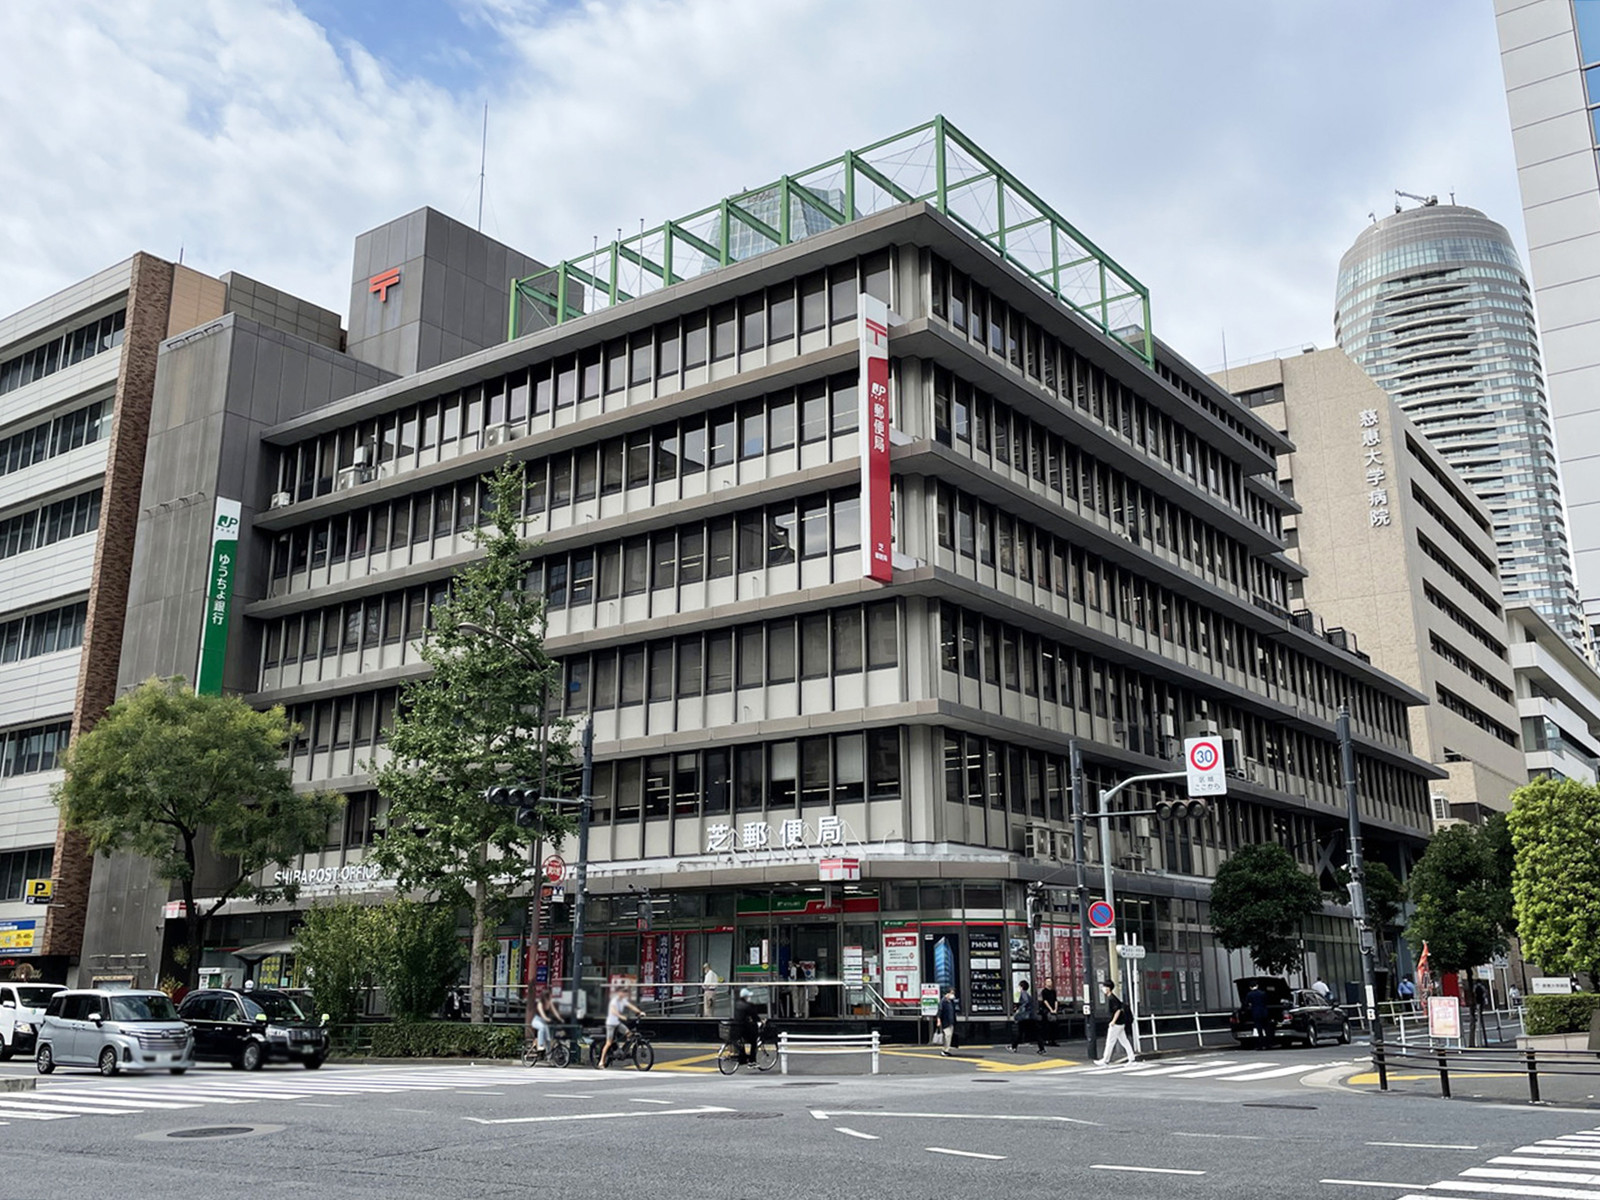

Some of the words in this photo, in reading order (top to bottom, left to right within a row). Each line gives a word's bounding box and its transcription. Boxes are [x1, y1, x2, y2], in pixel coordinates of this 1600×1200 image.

[874, 402, 885, 453] 郵便局
[212, 554, 230, 626] ゆうちょ銀行
[1196, 749, 1213, 764] 30
[706, 816, 842, 852] 芝郵便局
[34, 882, 46, 895] P
[274, 868, 308, 885] SHIBA
[309, 866, 339, 883] POST
